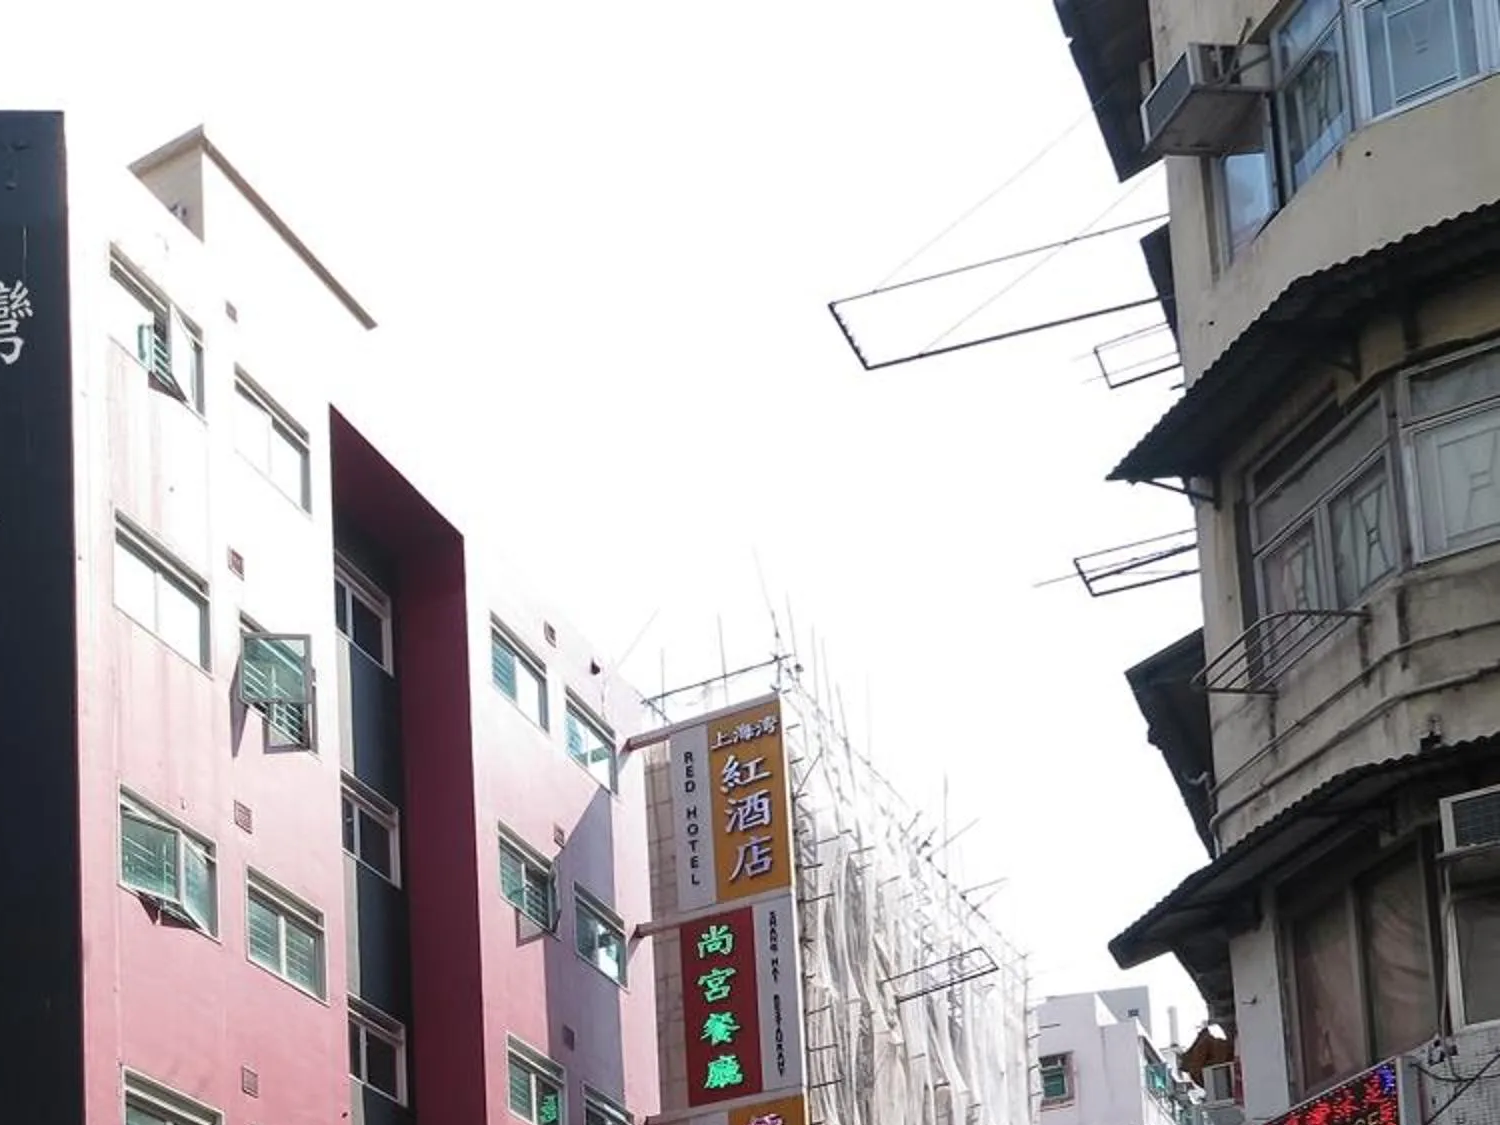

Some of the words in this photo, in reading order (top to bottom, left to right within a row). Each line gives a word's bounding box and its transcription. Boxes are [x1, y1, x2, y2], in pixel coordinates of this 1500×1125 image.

[684, 750, 695, 793] RED
[719, 754, 773, 884] 紅酒店
[684, 804, 700, 887] HOTEL
[697, 923, 744, 1090] 尚宮餐廳
